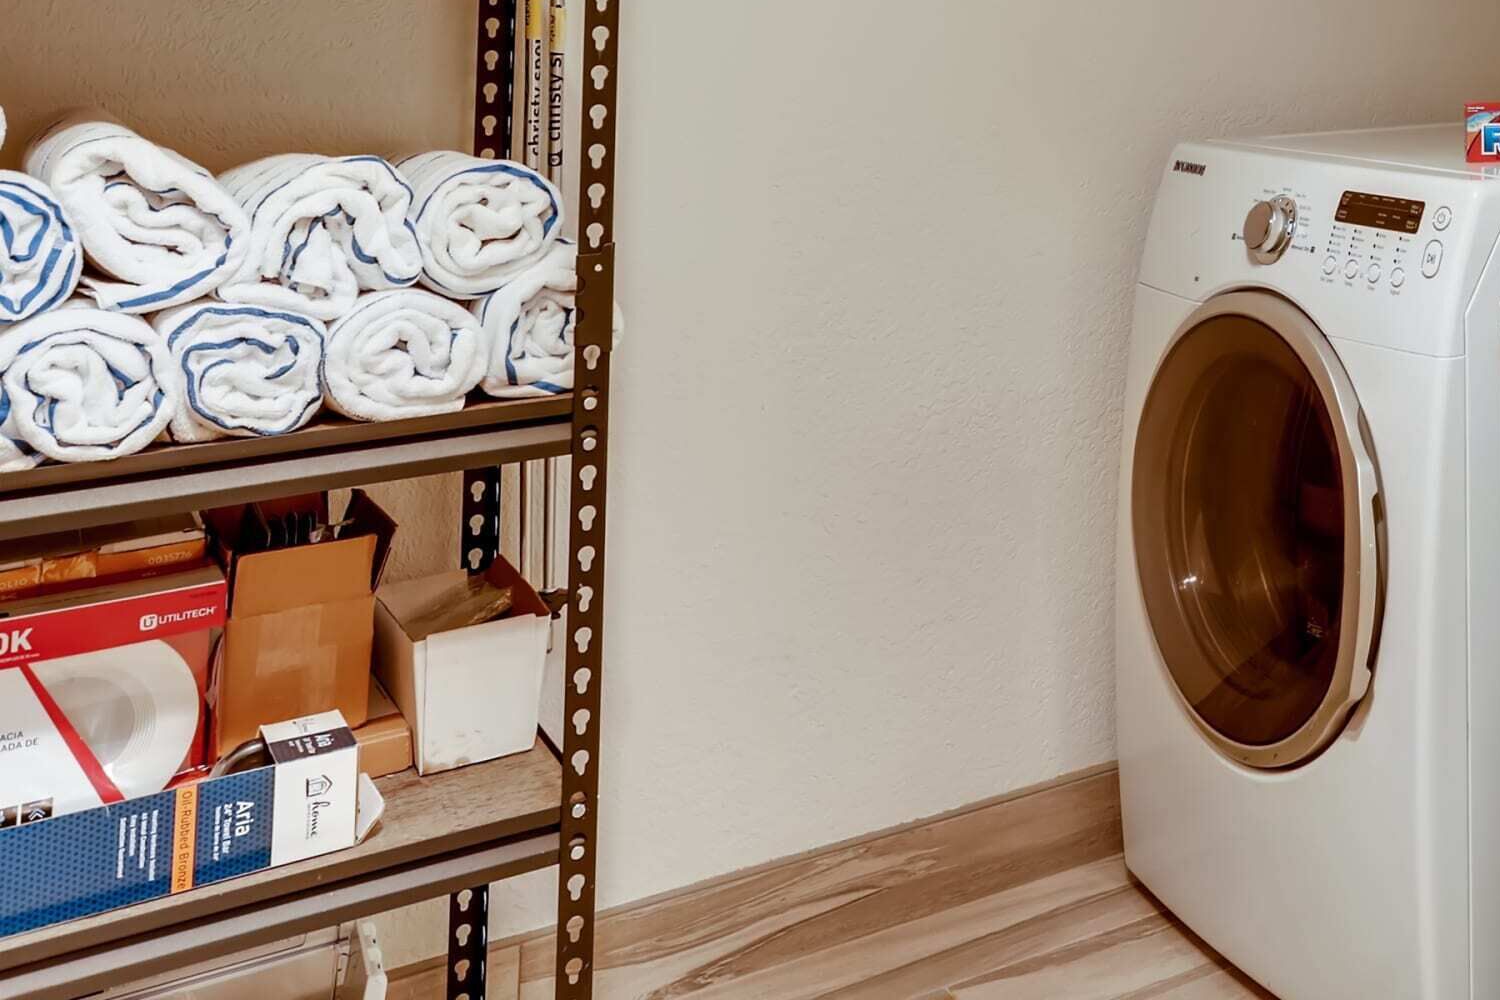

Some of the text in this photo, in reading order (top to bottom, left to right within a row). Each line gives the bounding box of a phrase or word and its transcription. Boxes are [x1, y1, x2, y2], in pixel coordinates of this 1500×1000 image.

[158, 607, 215, 625] UTILITECH
[222, 817, 233, 840] Towel
[235, 801, 255, 837] Aria
[310, 801, 331, 838] home
[177, 791, 193, 890] Oil-Rubbed Bronze
